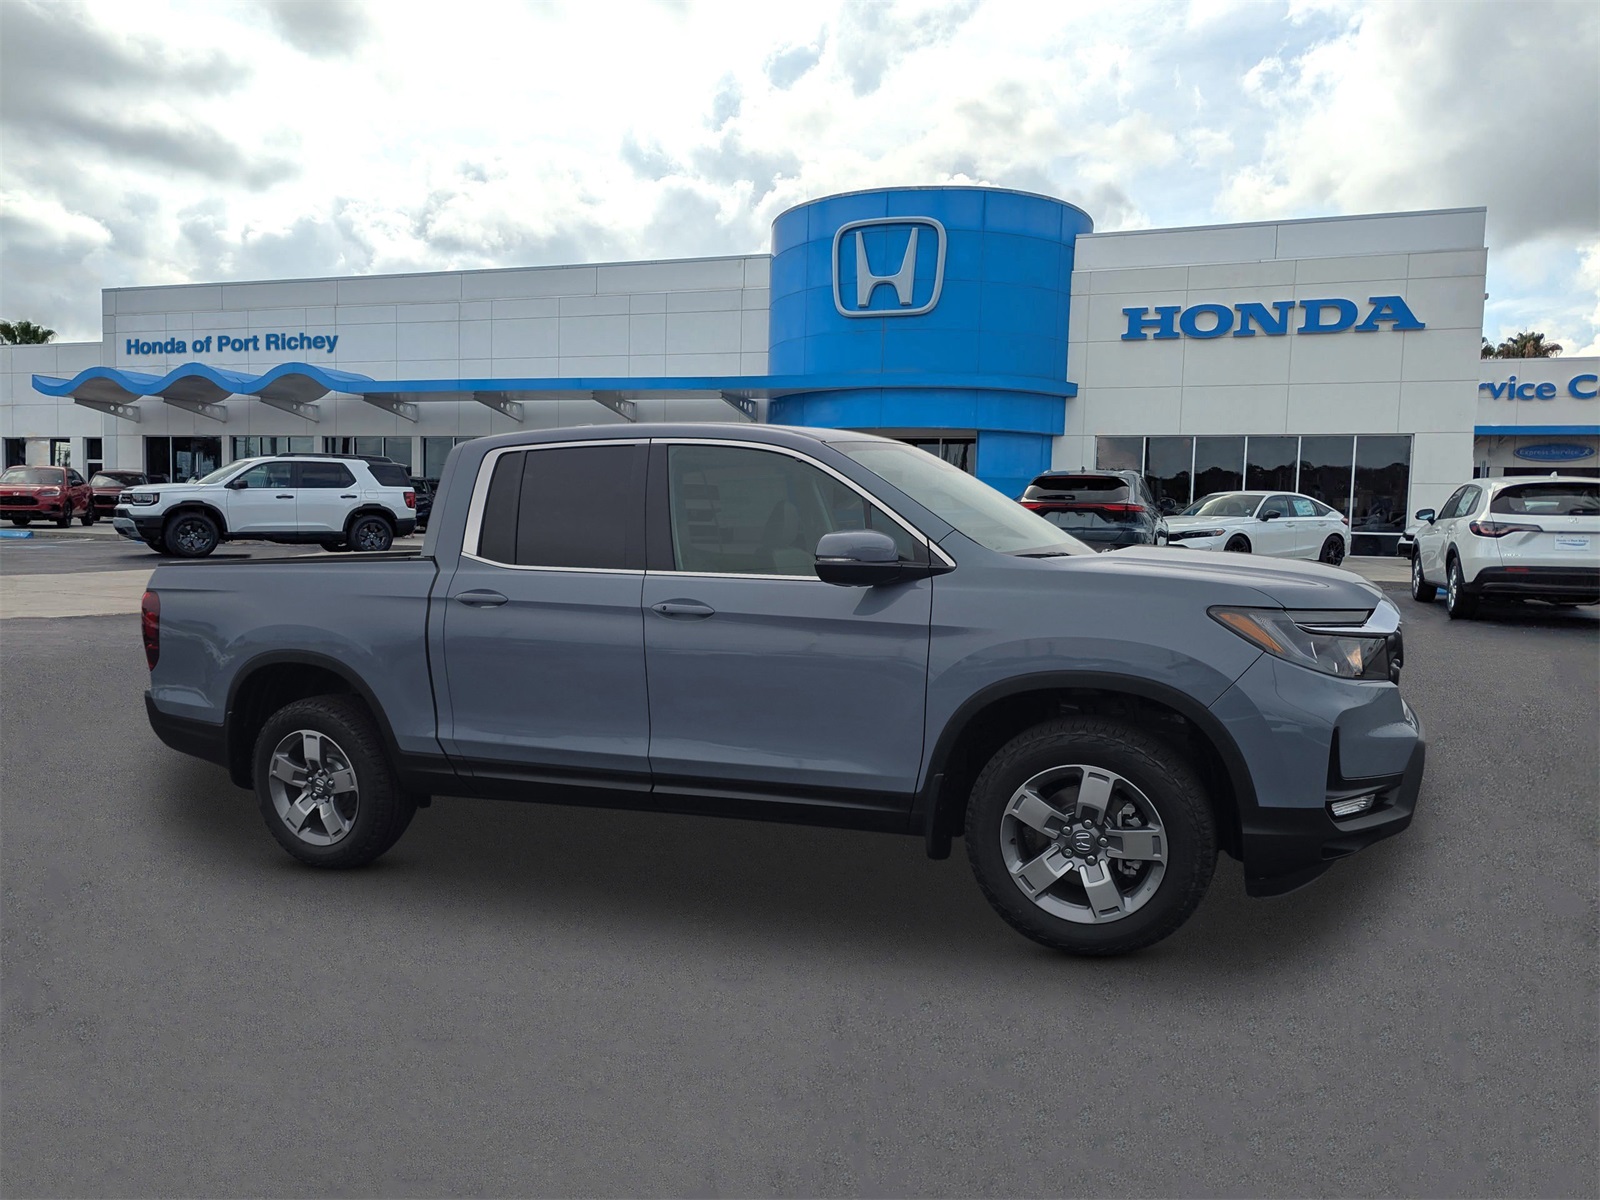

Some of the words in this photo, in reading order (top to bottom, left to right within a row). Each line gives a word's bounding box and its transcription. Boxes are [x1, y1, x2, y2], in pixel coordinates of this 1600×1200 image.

[1121, 295, 1425, 340] HONDA
[126, 337, 187, 355] Honda
[192, 336, 212, 353] of
[217, 334, 260, 352] Port
[265, 332, 339, 354] Richey
[1568, 373, 1600, 401] C
